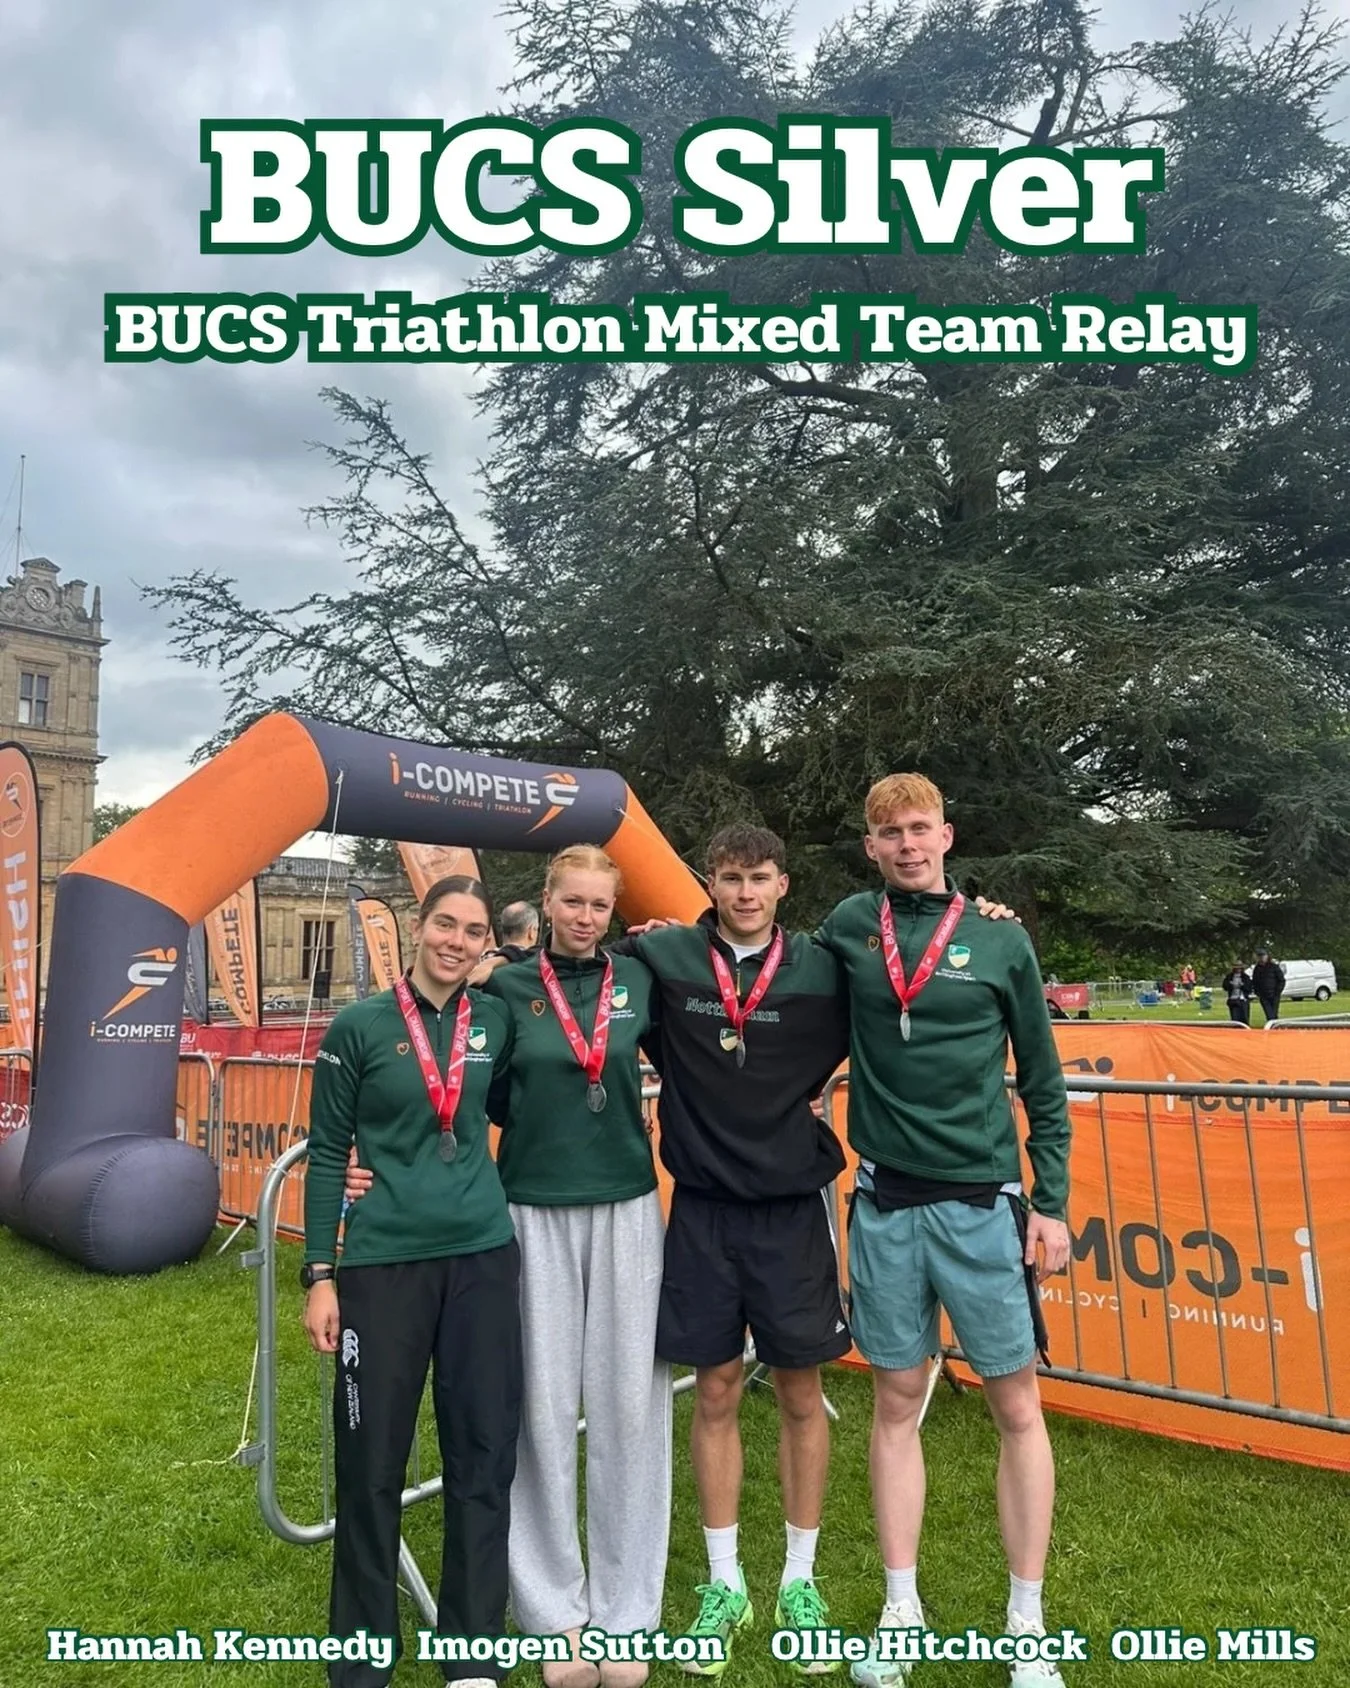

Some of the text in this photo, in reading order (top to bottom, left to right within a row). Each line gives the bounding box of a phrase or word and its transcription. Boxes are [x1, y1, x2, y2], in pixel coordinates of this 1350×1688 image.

[389, 752, 541, 805] i-COMPETE
[404, 790, 532, 814] RUNNING CYCLING TRIATHLON
[90, 1021, 176, 1037] i-COMPETE
[454, 1023, 468, 1053] BUCS
